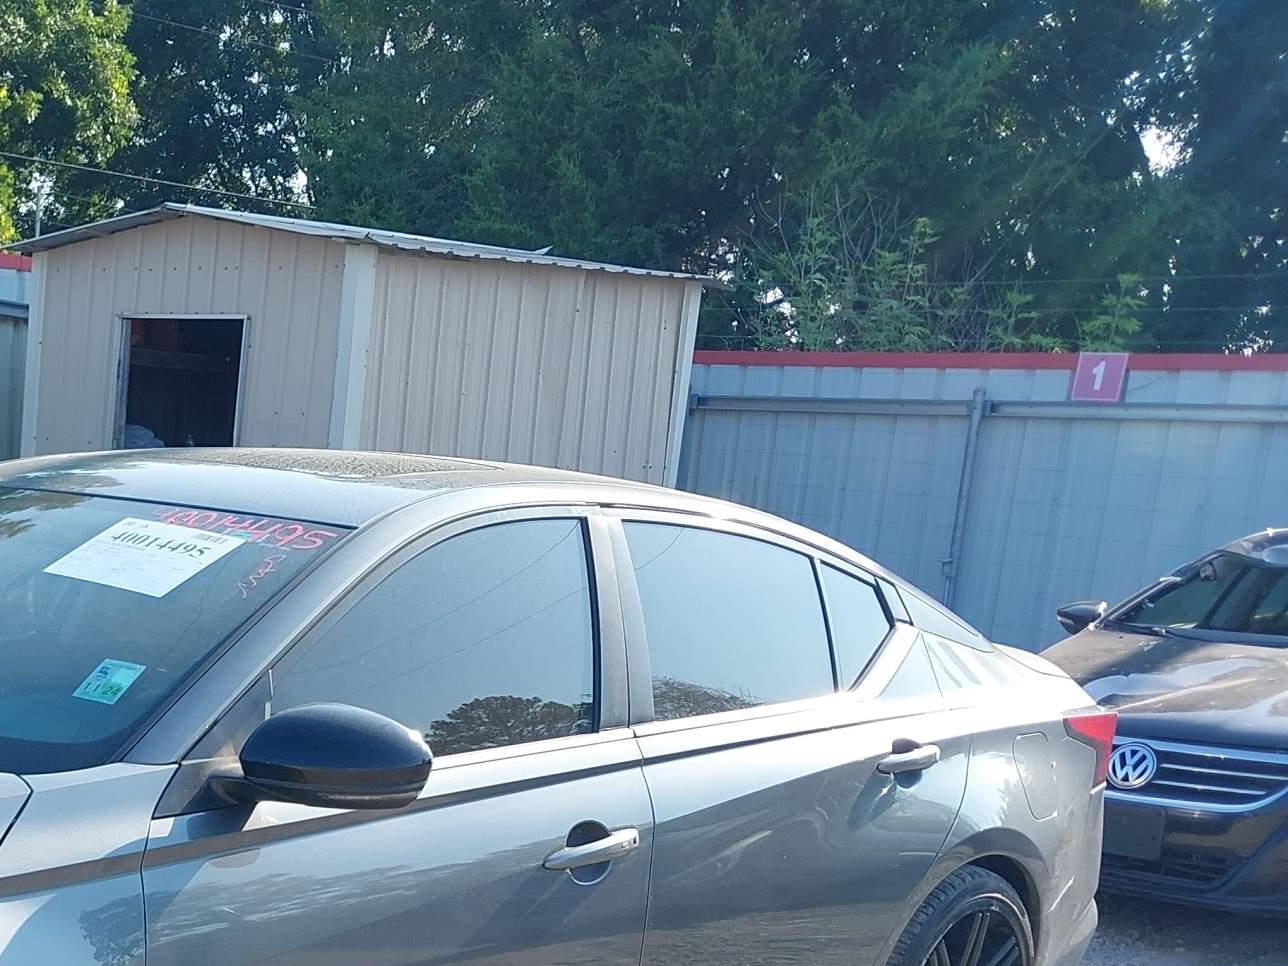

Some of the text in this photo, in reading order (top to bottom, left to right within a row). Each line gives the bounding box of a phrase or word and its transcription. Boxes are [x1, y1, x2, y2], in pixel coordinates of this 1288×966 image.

[1092, 360, 1107, 391] 1
[111, 530, 214, 559] 40014495
[152, 507, 338, 551] 40014495
